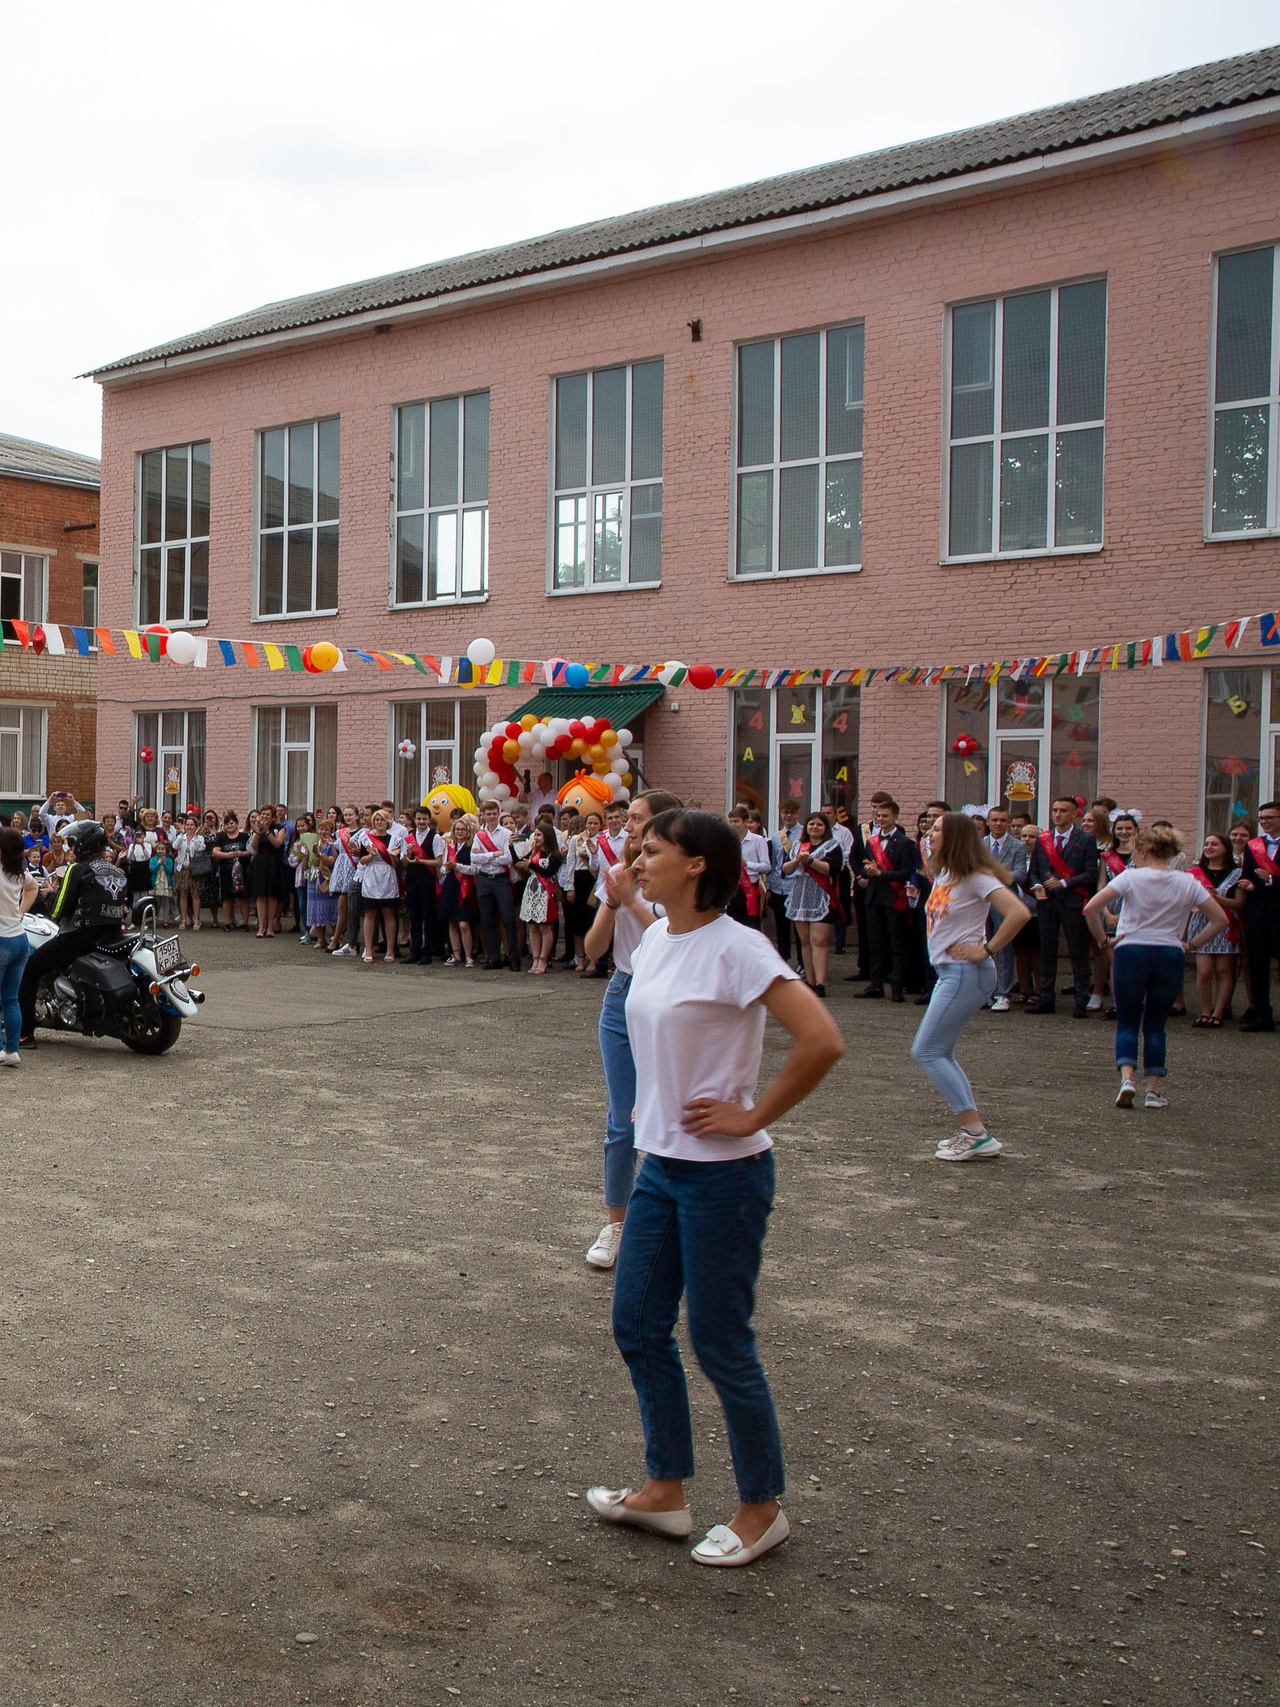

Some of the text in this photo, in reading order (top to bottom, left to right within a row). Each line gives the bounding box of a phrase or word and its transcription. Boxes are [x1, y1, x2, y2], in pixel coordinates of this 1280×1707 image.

[749, 711, 764, 730] 4
[832, 712, 849, 733] 4
[742, 747, 755, 761] А
[835, 766, 848, 781] А
[159, 941, 177, 956] 1502
[170, 953, 180, 965] 23
